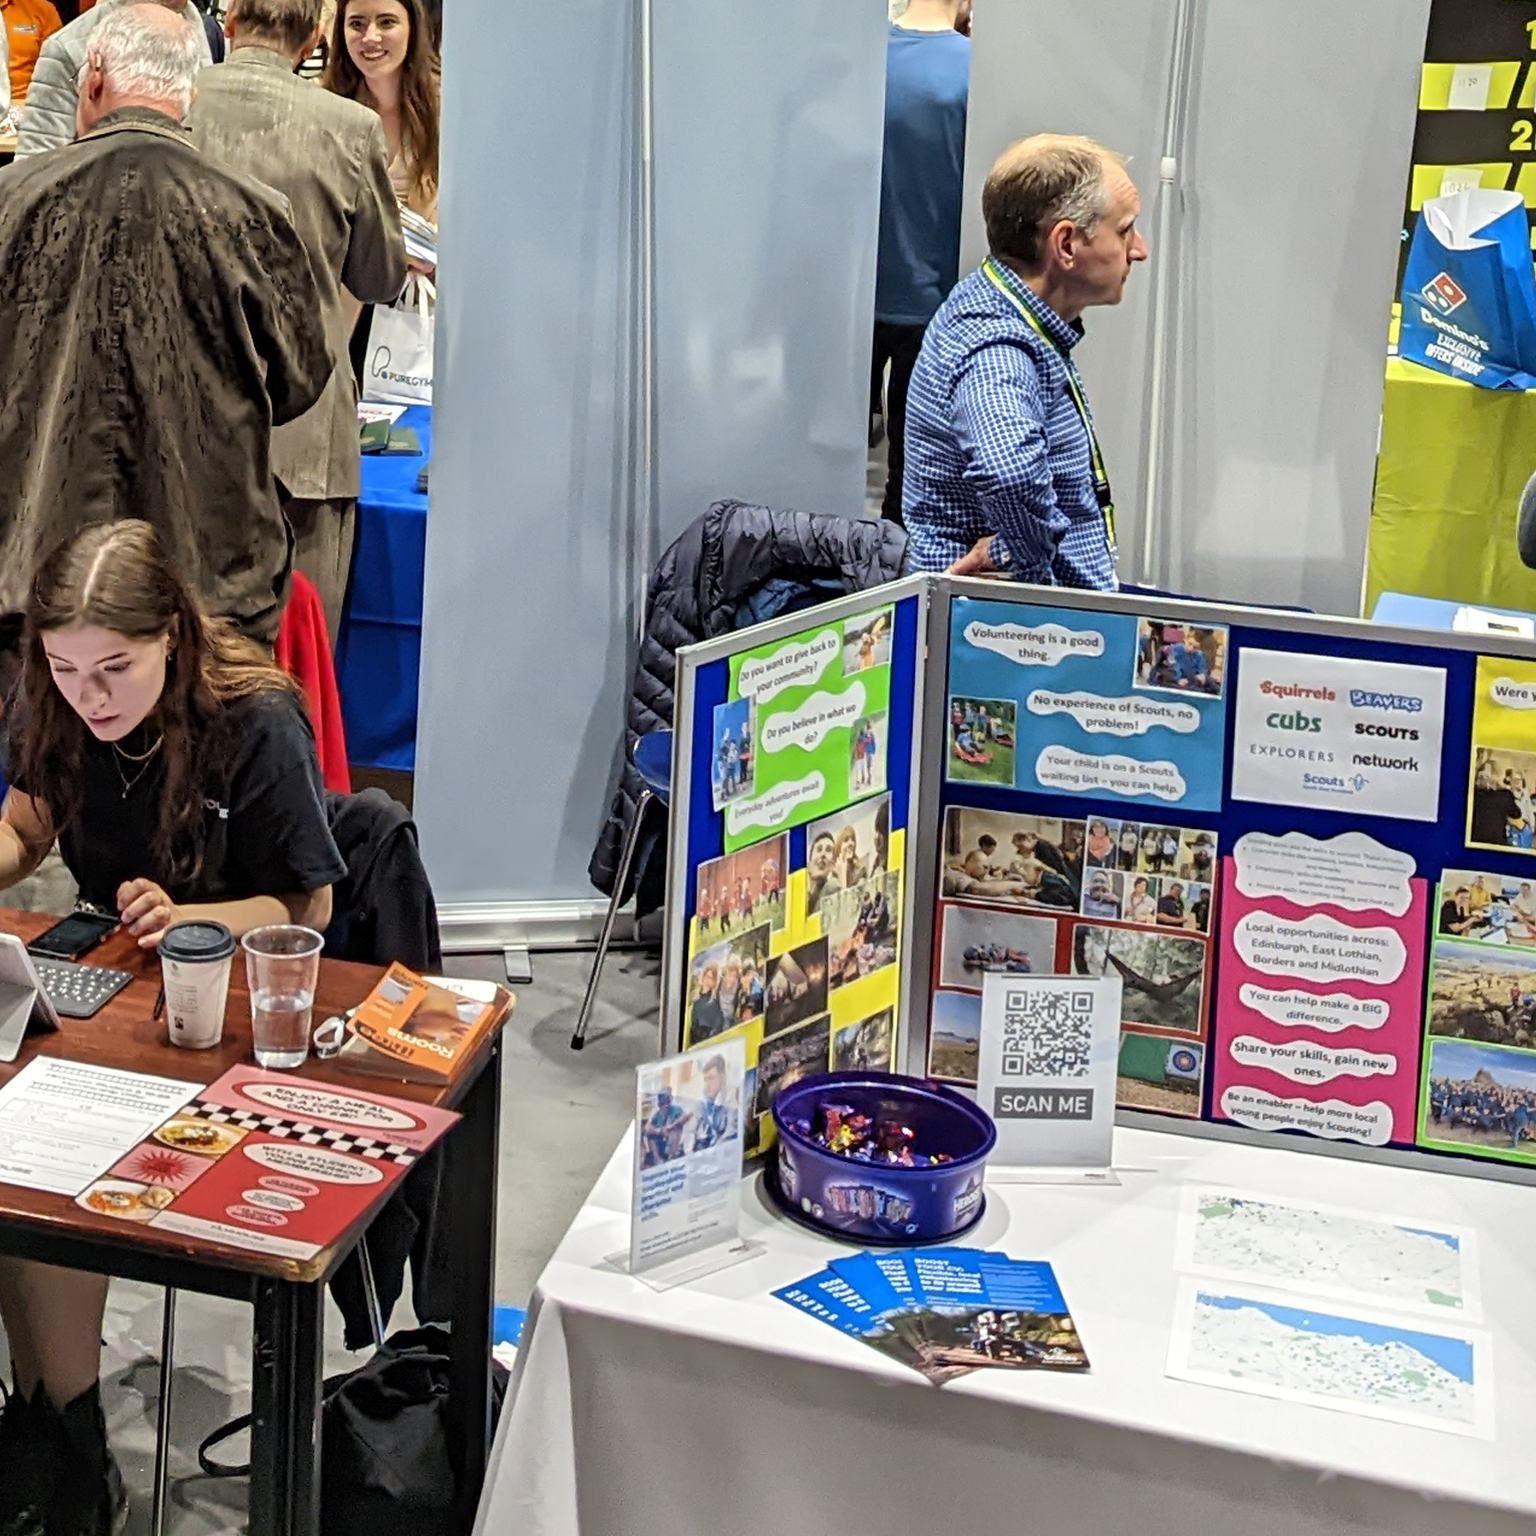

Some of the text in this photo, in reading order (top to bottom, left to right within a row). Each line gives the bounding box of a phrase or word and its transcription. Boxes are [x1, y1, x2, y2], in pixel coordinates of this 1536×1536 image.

[972, 628, 1098, 649] Volunteering is a good
[1018, 648, 1051, 661] thing.
[1260, 681, 1335, 702] Squirrels
[1350, 689, 1422, 712] BEAVERS
[1495, 686, 1528, 699] Were
[1034, 695, 1192, 719] No experience of Scouts, no
[1086, 716, 1139, 732] problem!
[1266, 711, 1322, 733] cubs
[1250, 744, 1334, 762] EXPLORERS
[1353, 754, 1418, 772] network
[1304, 773, 1344, 788] Scouts
[1246, 922, 1389, 947] Local opportunities across:
[1252, 939, 1382, 962] Edinburgh, East Lothian,
[1253, 955, 1379, 977] Borders and Midlothian
[1234, 1042, 1389, 1069] Share your skills, gain new
[1294, 1068, 1325, 1078] ones.
[1001, 1095, 1087, 1113] SCAN ME
